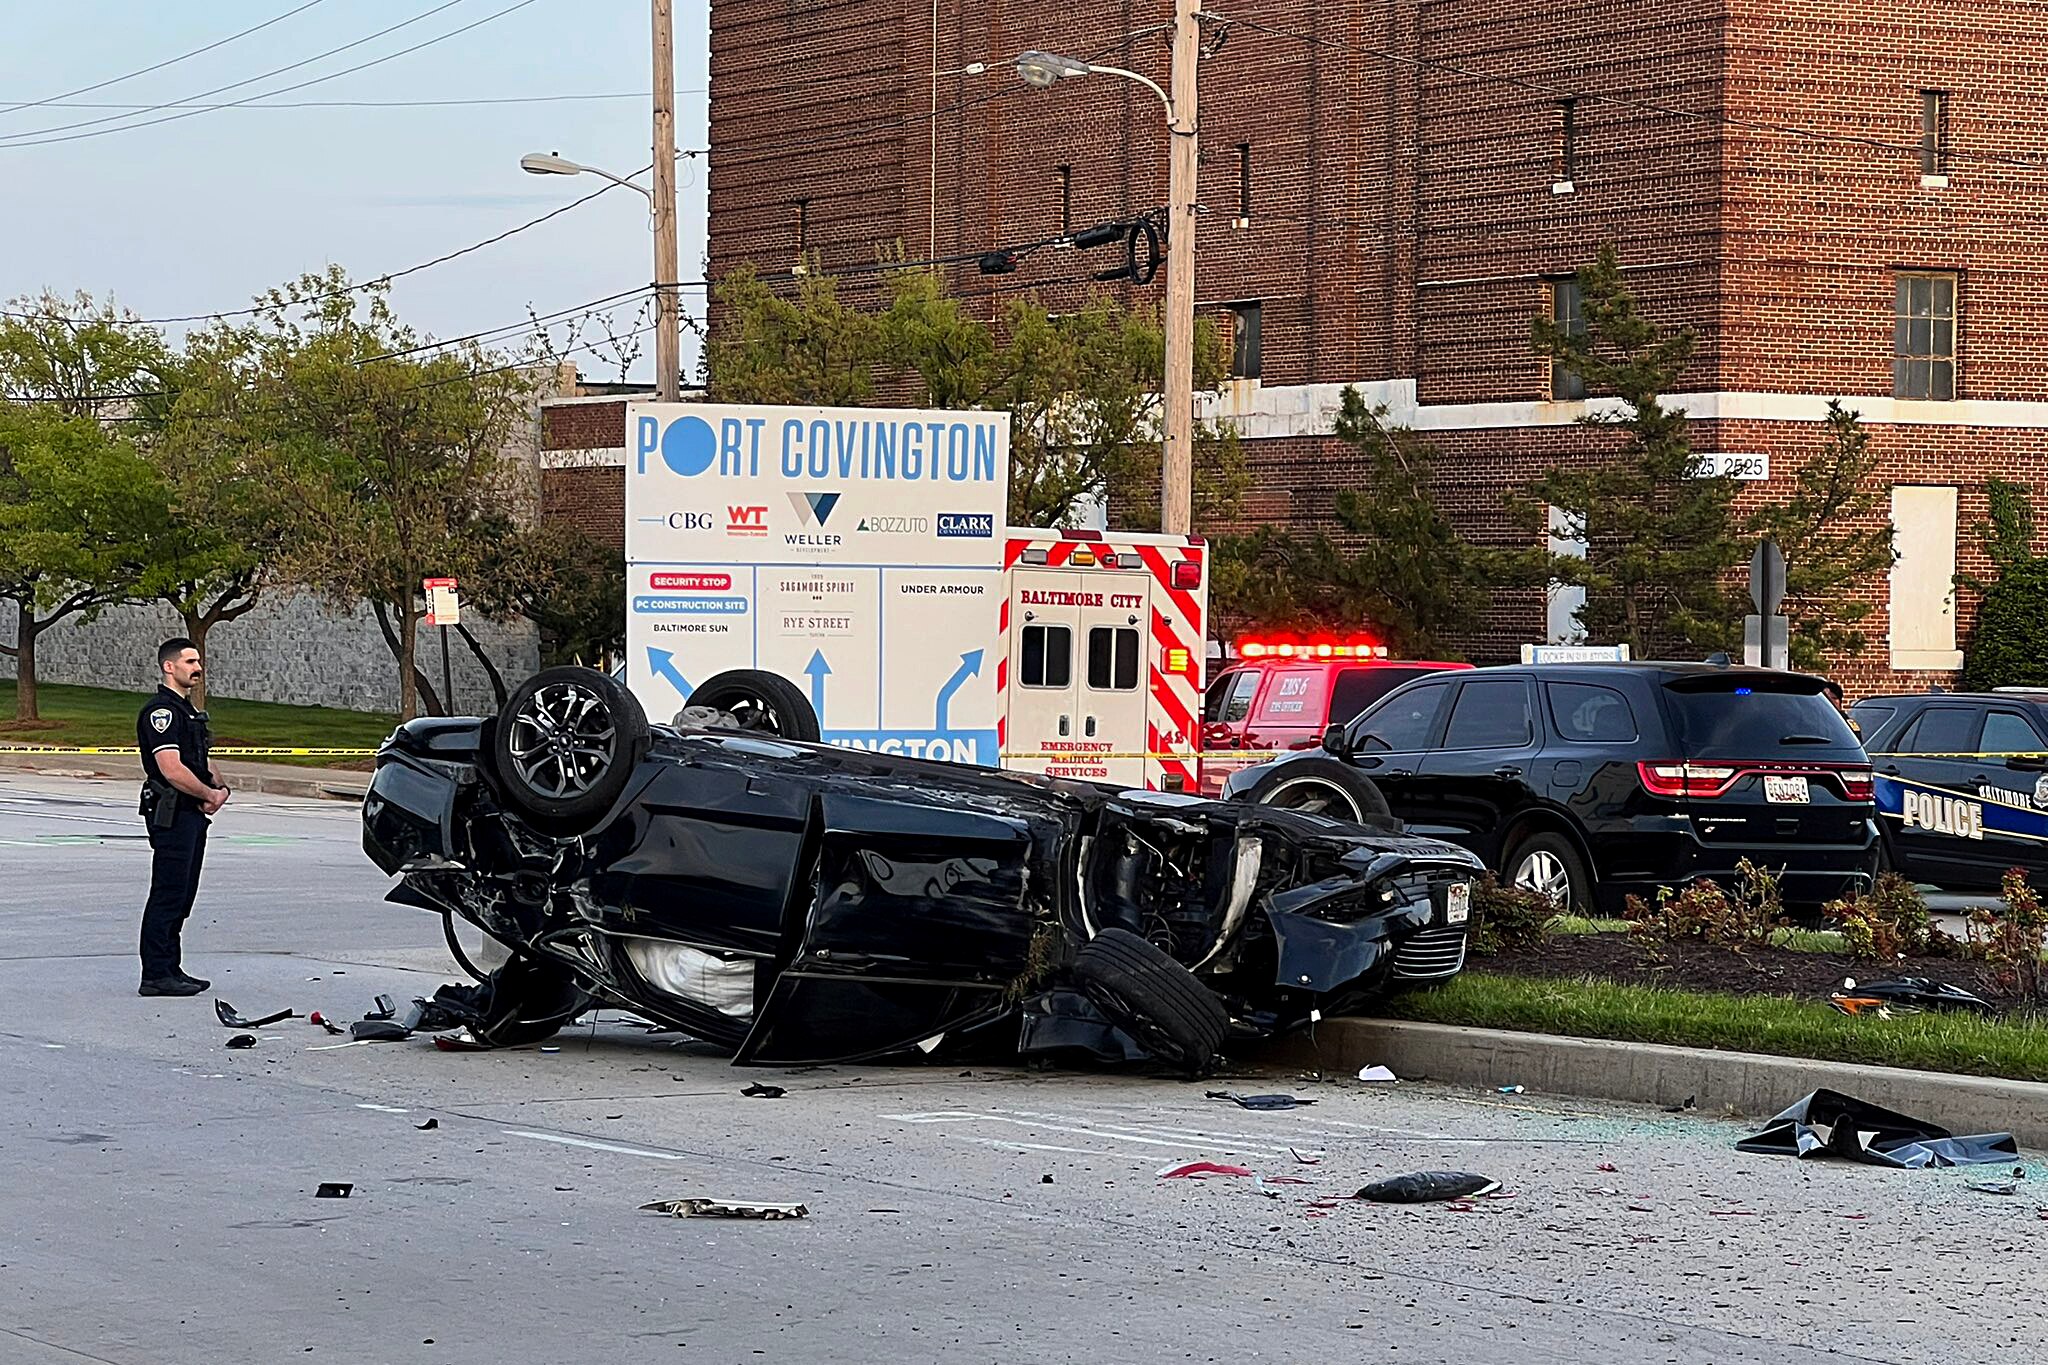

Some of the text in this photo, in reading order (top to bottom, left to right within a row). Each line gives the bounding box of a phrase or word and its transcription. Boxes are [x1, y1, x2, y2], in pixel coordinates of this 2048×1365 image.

[637, 415, 996, 482] PORT COVINGTON
[669, 512, 713, 530] CBG
[727, 506, 768, 524] WT
[870, 516, 928, 533] BOZZUTO
[939, 516, 991, 530] CLARK
[784, 534, 842, 546] WELLER
[654, 577, 728, 587] SECURITY STOP
[780, 581, 855, 593] SAGAMORE SPIRIT
[901, 585, 984, 595] UNDER ARMOUR
[636, 600, 745, 610] PC CONSTRUCTION SITE
[1021, 590, 1143, 609] BALTIMORE CITY
[653, 624, 729, 633] BALTIMORE SUN
[783, 617, 850, 630] RYE STREET
[1041, 741, 1113, 752] EMERGENCY
[1045, 767, 1107, 777] SERVICES
[1979, 785, 2031, 808] BALTIMORE
[1903, 789, 1983, 840] POLICE
